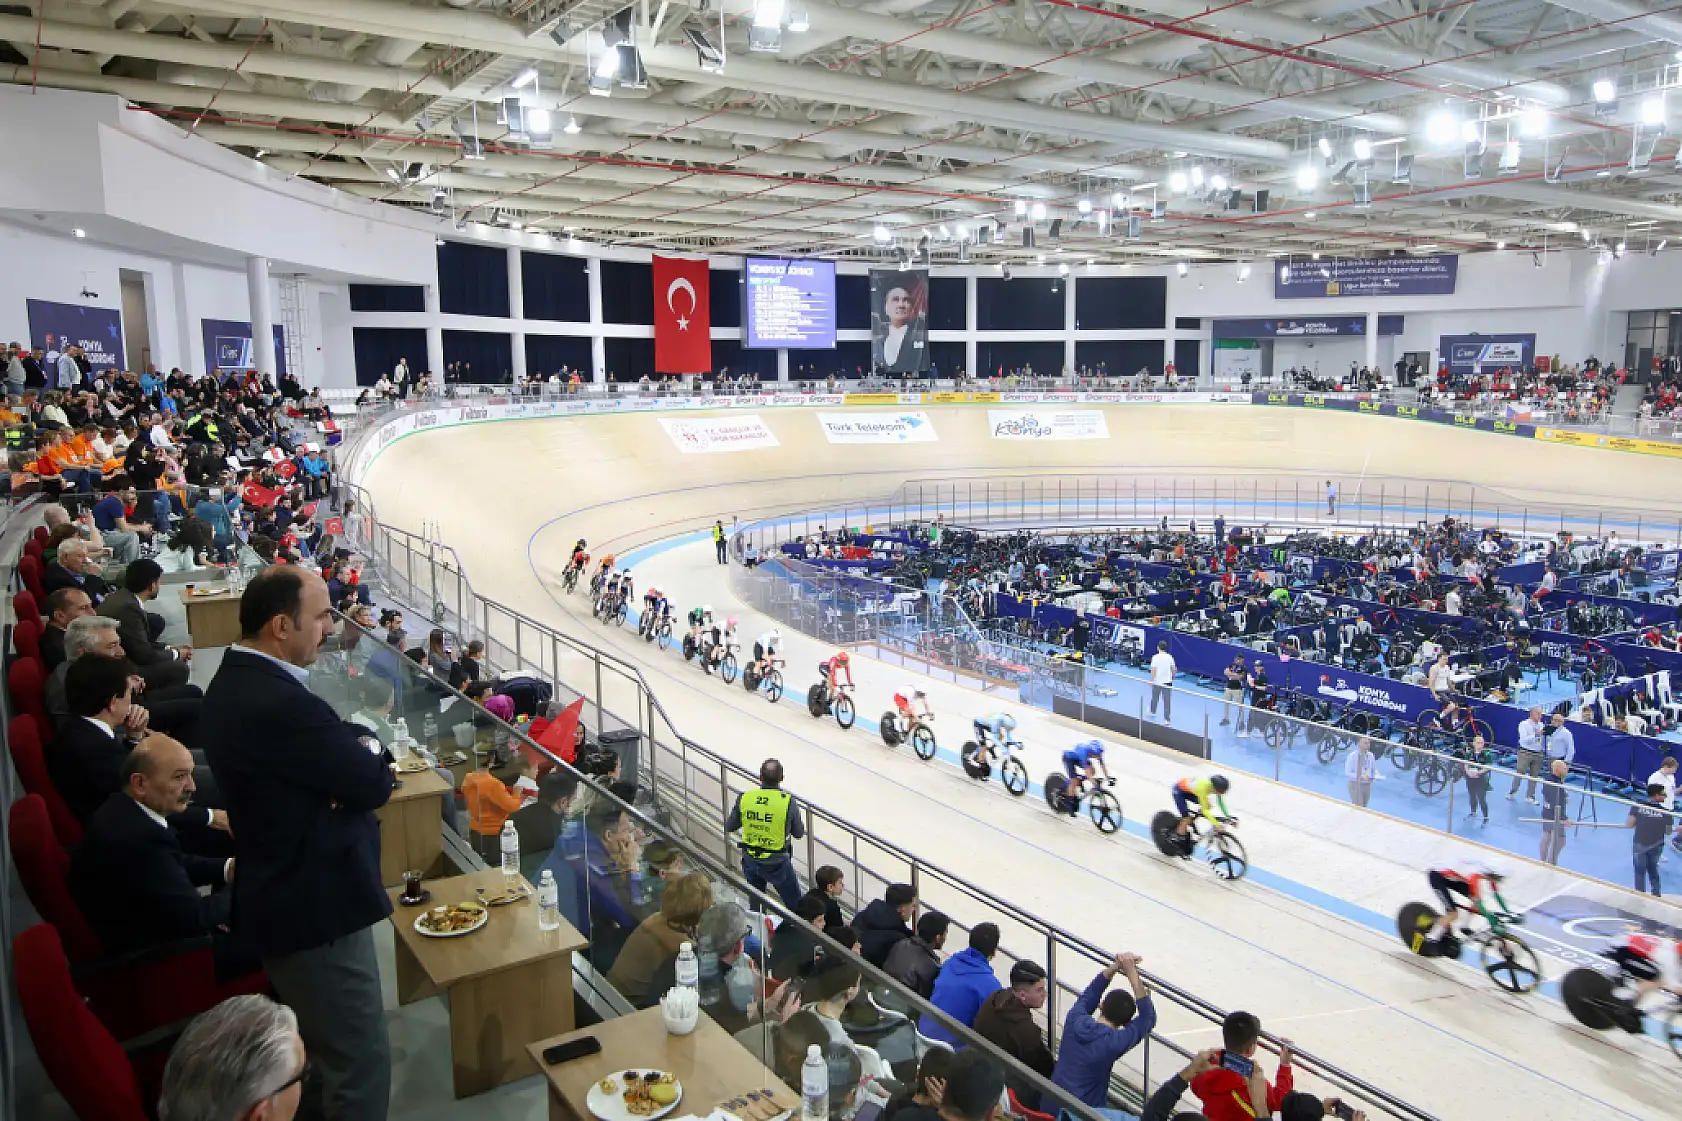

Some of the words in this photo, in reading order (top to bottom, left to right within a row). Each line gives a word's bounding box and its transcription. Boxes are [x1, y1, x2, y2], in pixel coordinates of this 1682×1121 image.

[825, 422, 852, 431] Türk
[855, 422, 906, 432] Telekom
[1359, 685, 1390, 700] KONYA
[1359, 694, 1407, 713] VELODROME
[756, 796, 769, 805] 22
